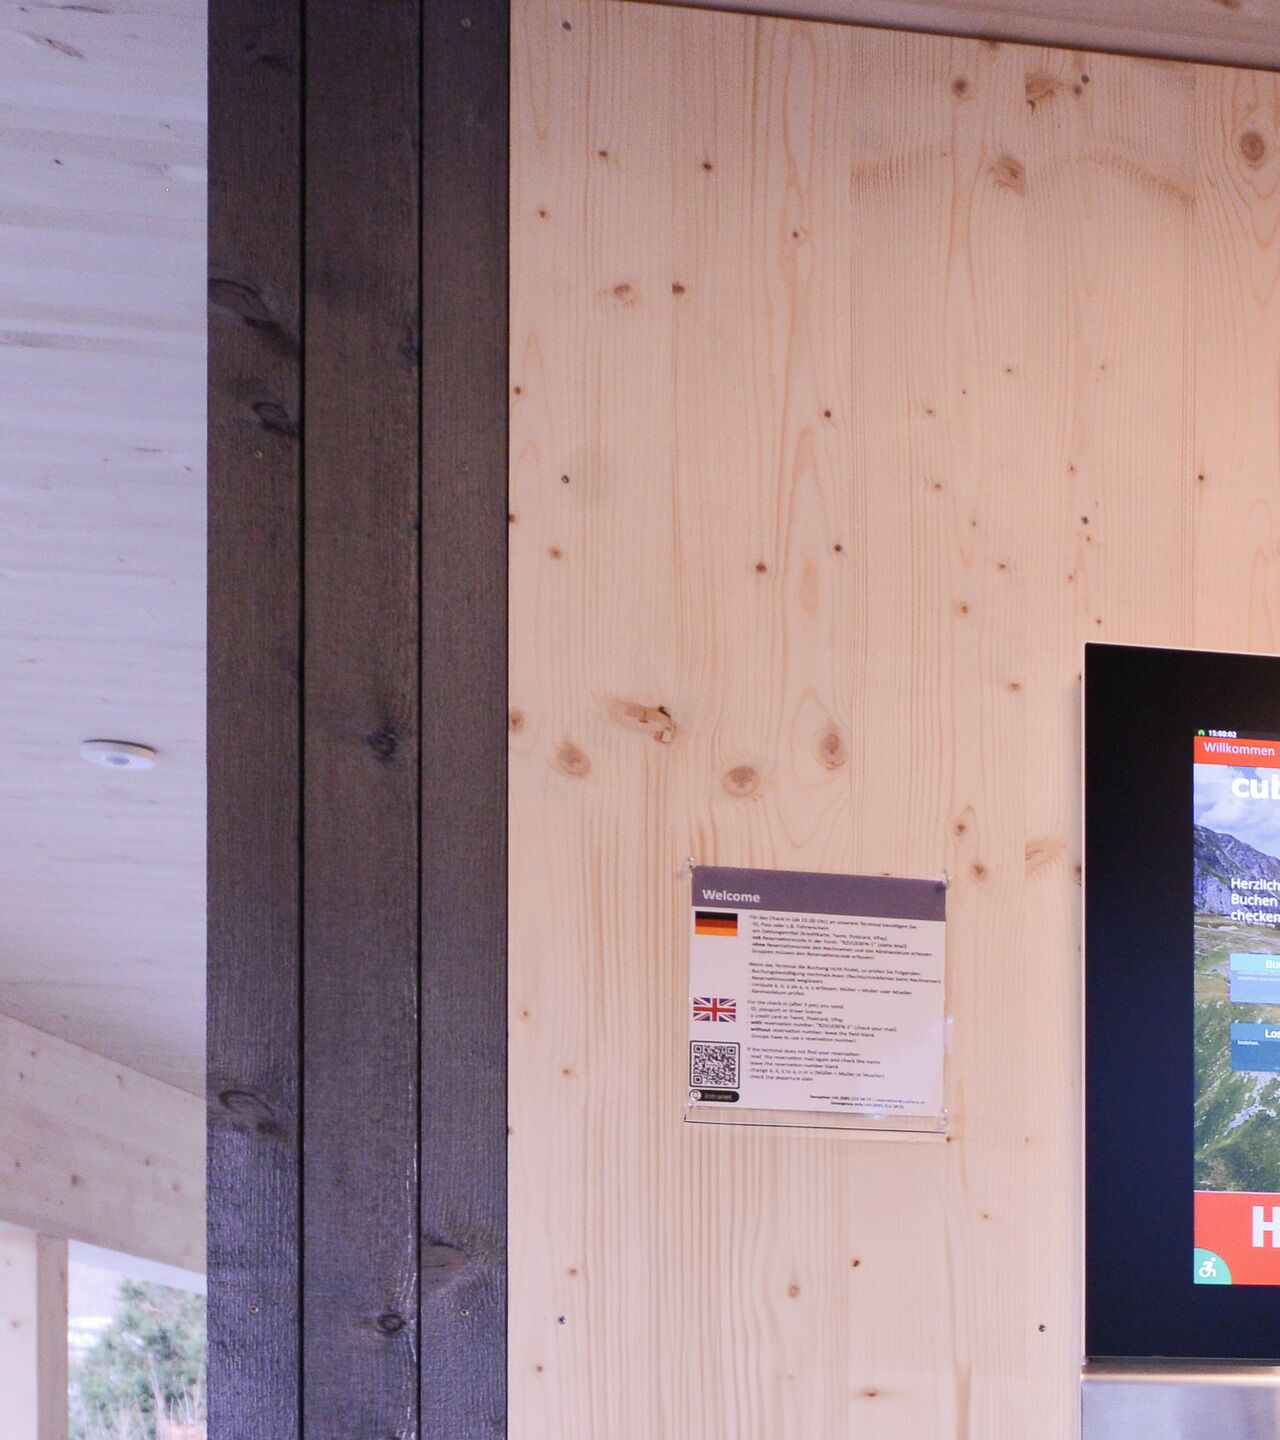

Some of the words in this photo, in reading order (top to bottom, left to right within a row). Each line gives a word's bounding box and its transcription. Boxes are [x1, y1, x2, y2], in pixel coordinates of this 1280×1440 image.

[1203, 742, 1275, 756] Willkommen
[1231, 878, 1280, 892] Herzlich
[702, 889, 761, 903] Welcome
[1231, 894, 1278, 907] Buchen
